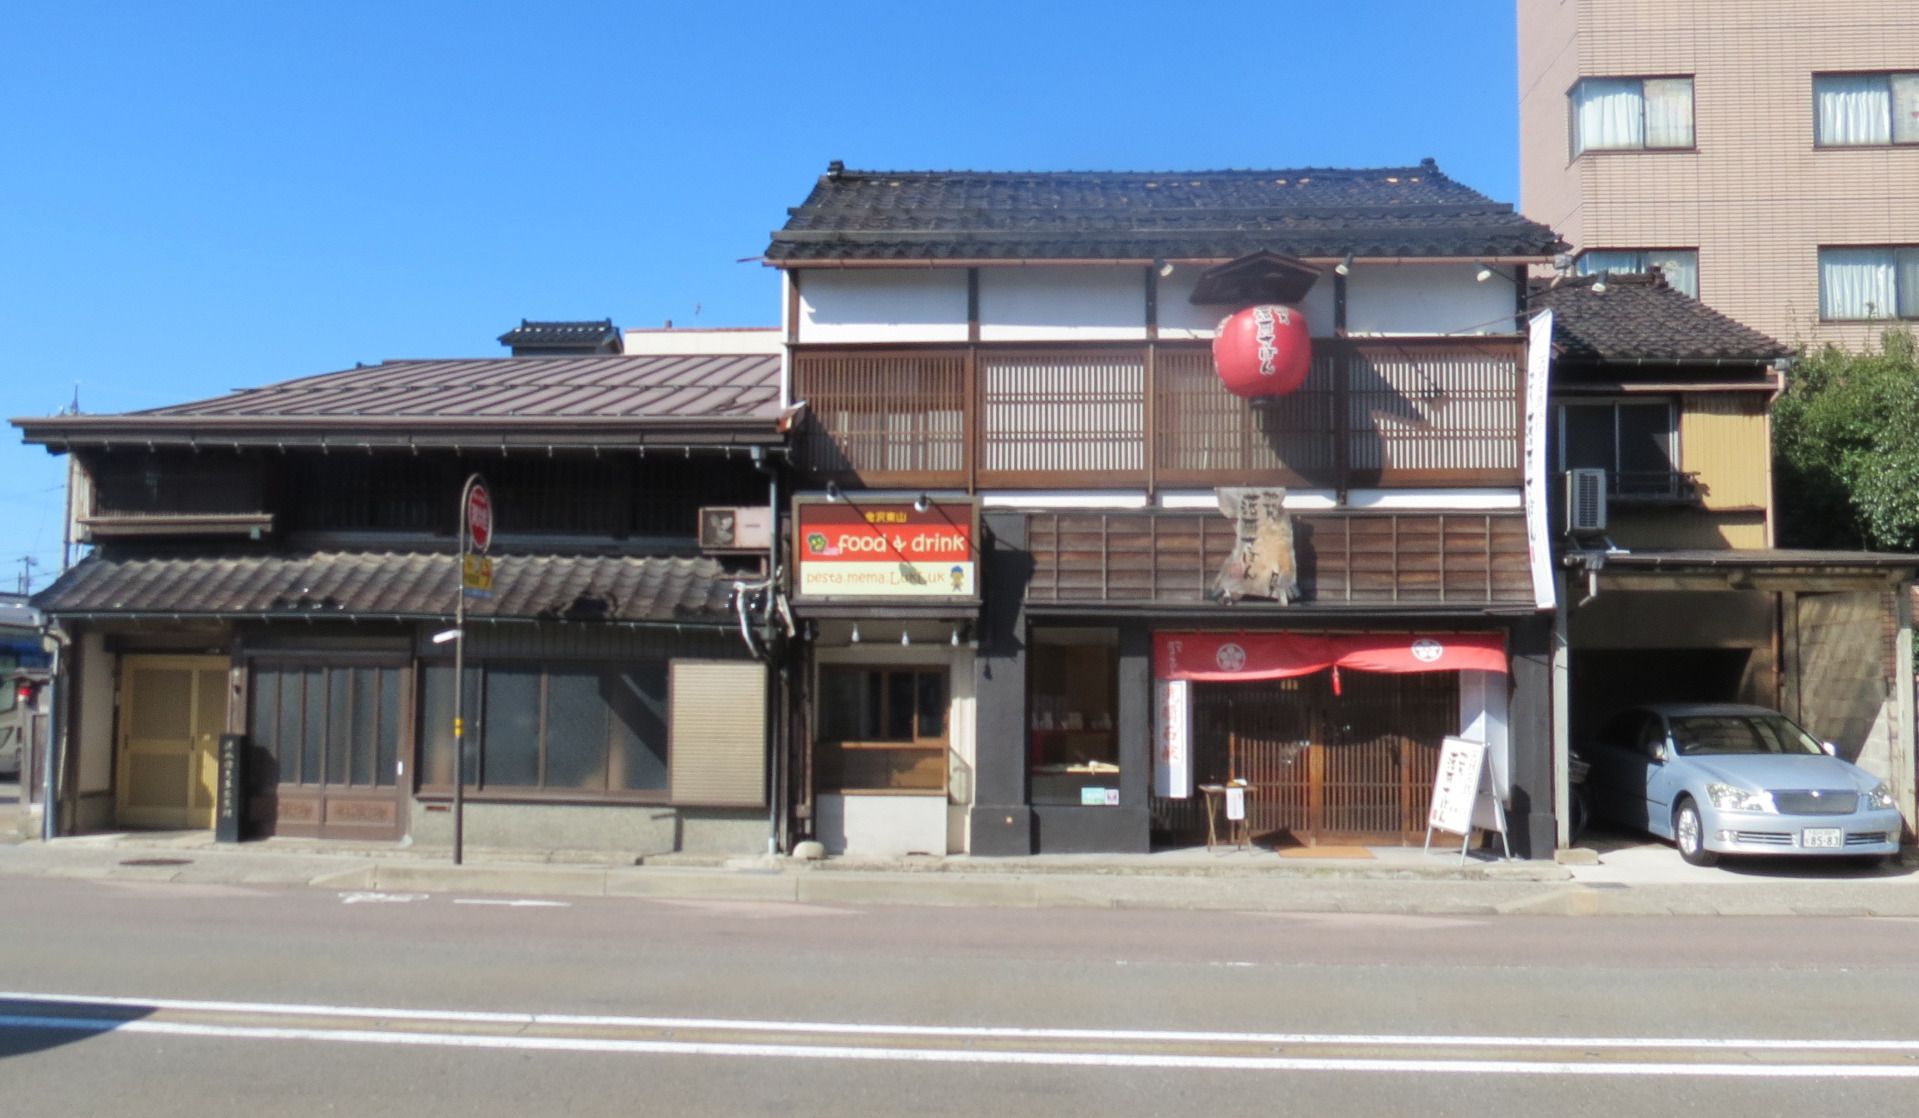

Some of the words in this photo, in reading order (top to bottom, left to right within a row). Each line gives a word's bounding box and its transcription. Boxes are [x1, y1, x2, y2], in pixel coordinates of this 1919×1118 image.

[838, 533, 887, 554] food
[892, 535, 907, 552] &
[911, 533, 965, 552] drink
[806, 571, 843, 585] pesta
[847, 572, 885, 584] mema
